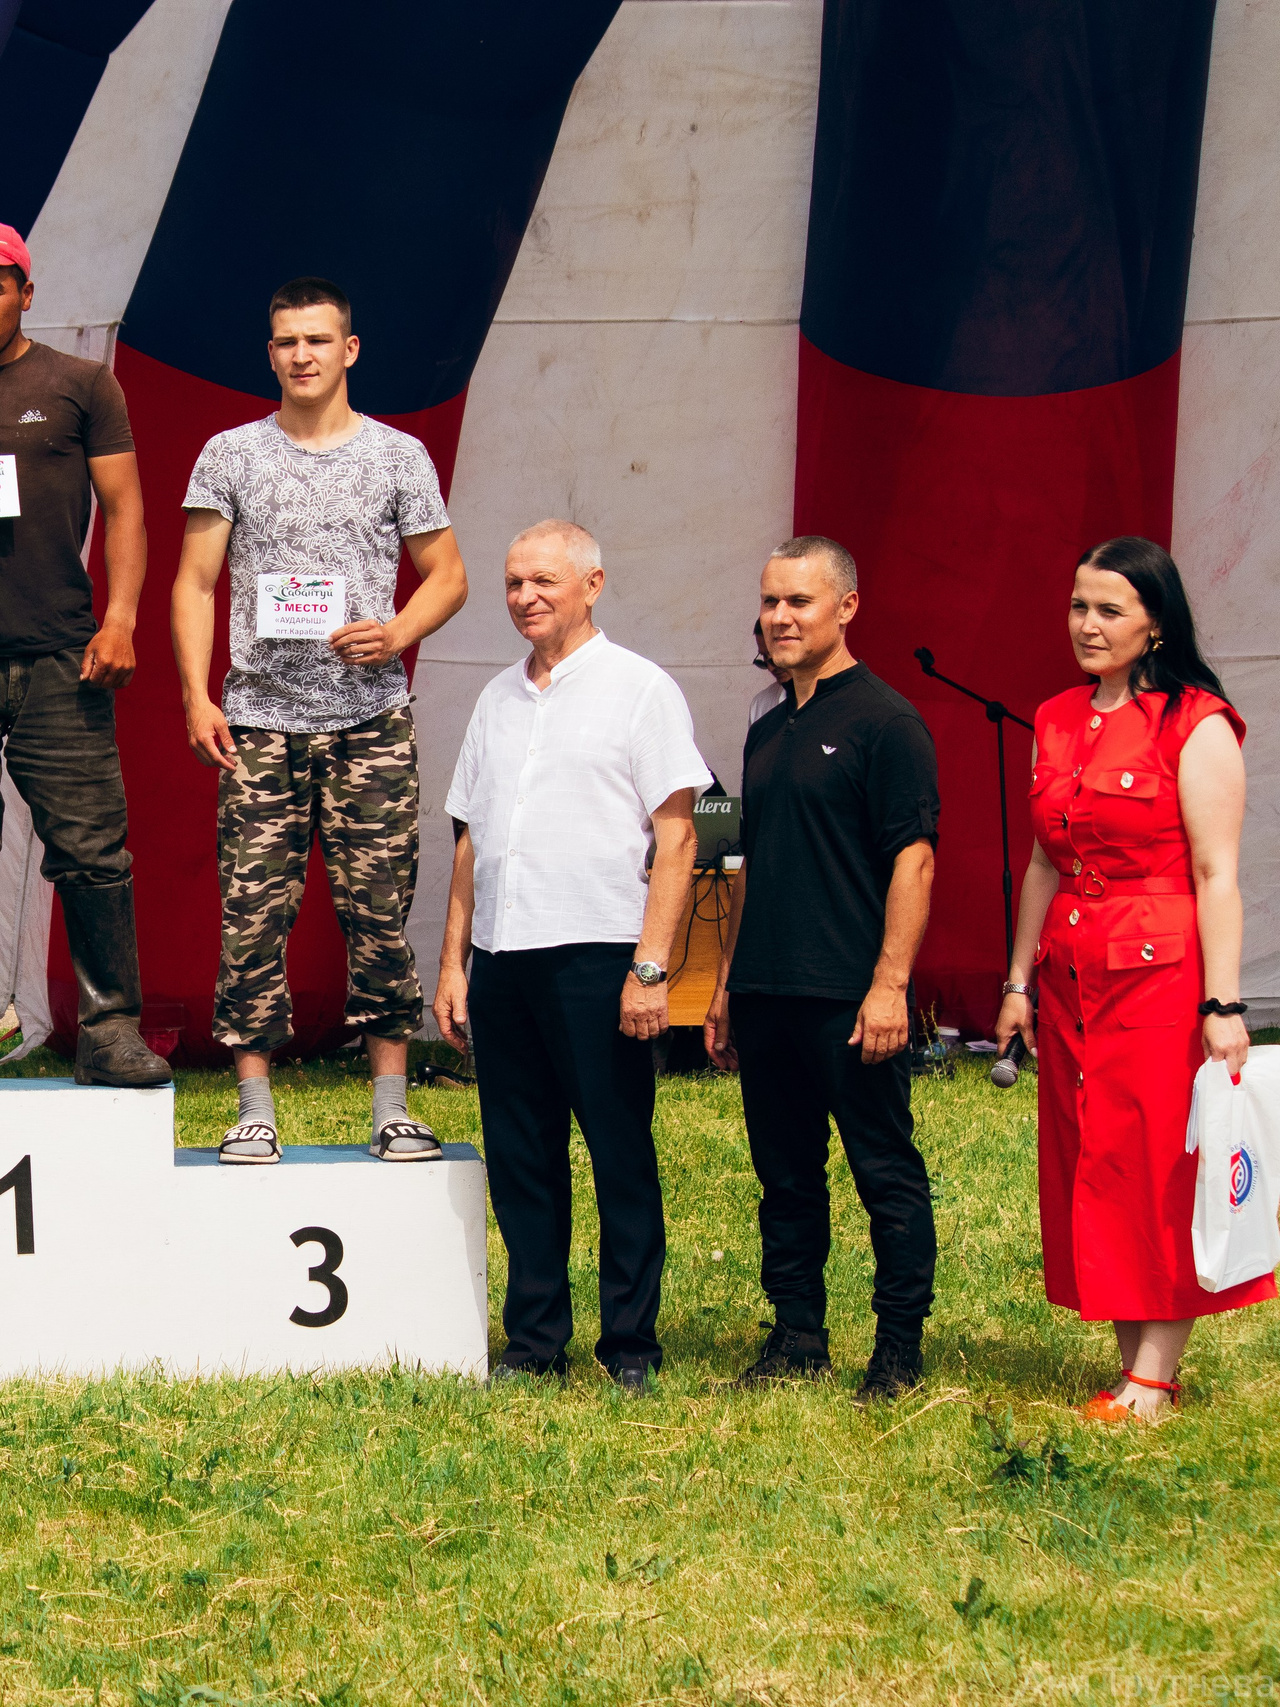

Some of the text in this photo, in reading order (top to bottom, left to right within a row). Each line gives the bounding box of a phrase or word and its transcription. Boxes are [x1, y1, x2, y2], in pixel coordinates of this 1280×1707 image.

[281, 587, 334, 600] Сабантуй
[274, 603, 328, 613] 3 МЕСТО
[275, 616, 327, 625] «АУДАРЫШ»
[275, 628, 325, 637] пгт.Карабаш
[288, 1225, 350, 1328] 3
